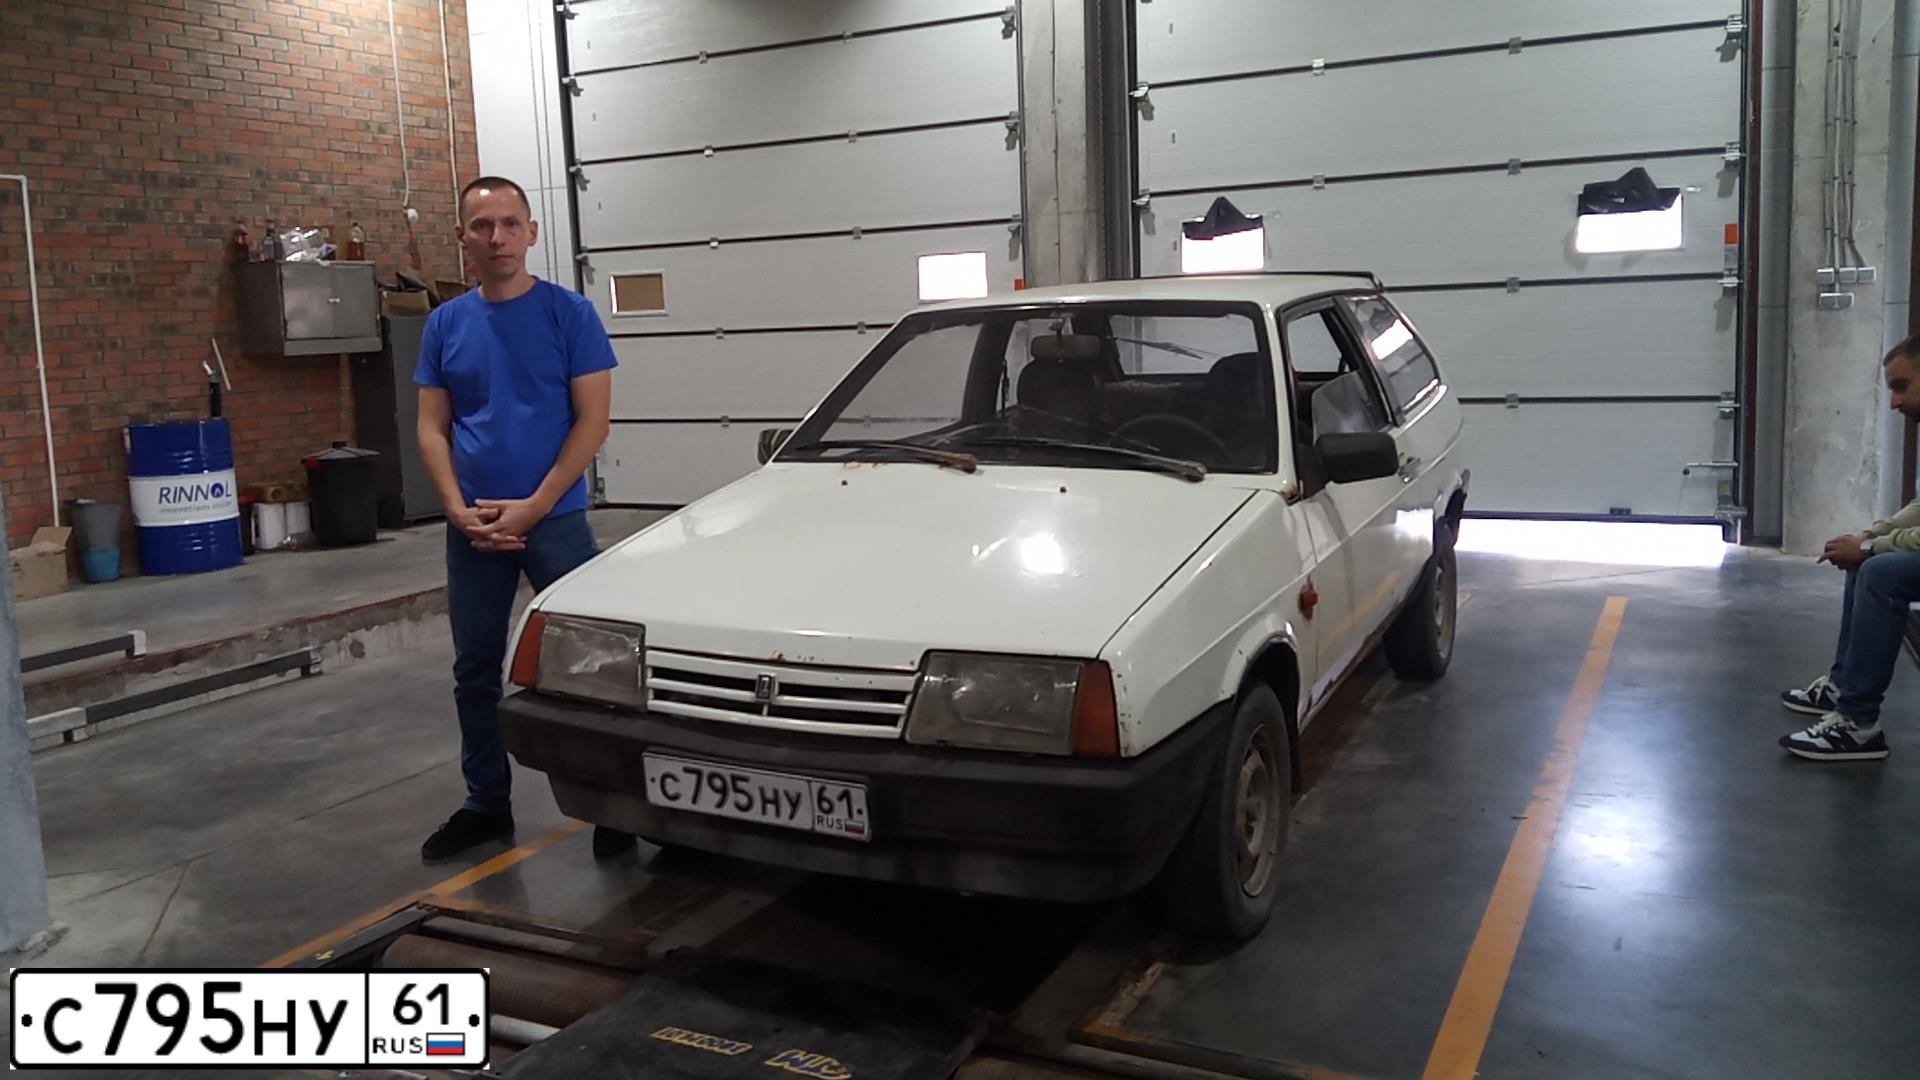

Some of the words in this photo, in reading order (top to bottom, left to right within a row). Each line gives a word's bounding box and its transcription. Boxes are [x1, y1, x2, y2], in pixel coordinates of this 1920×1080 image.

[159, 481, 233, 504] RINNOL
[659, 766, 802, 821] С795НУ
[816, 785, 854, 819] 61
[816, 814, 844, 831] RUS
